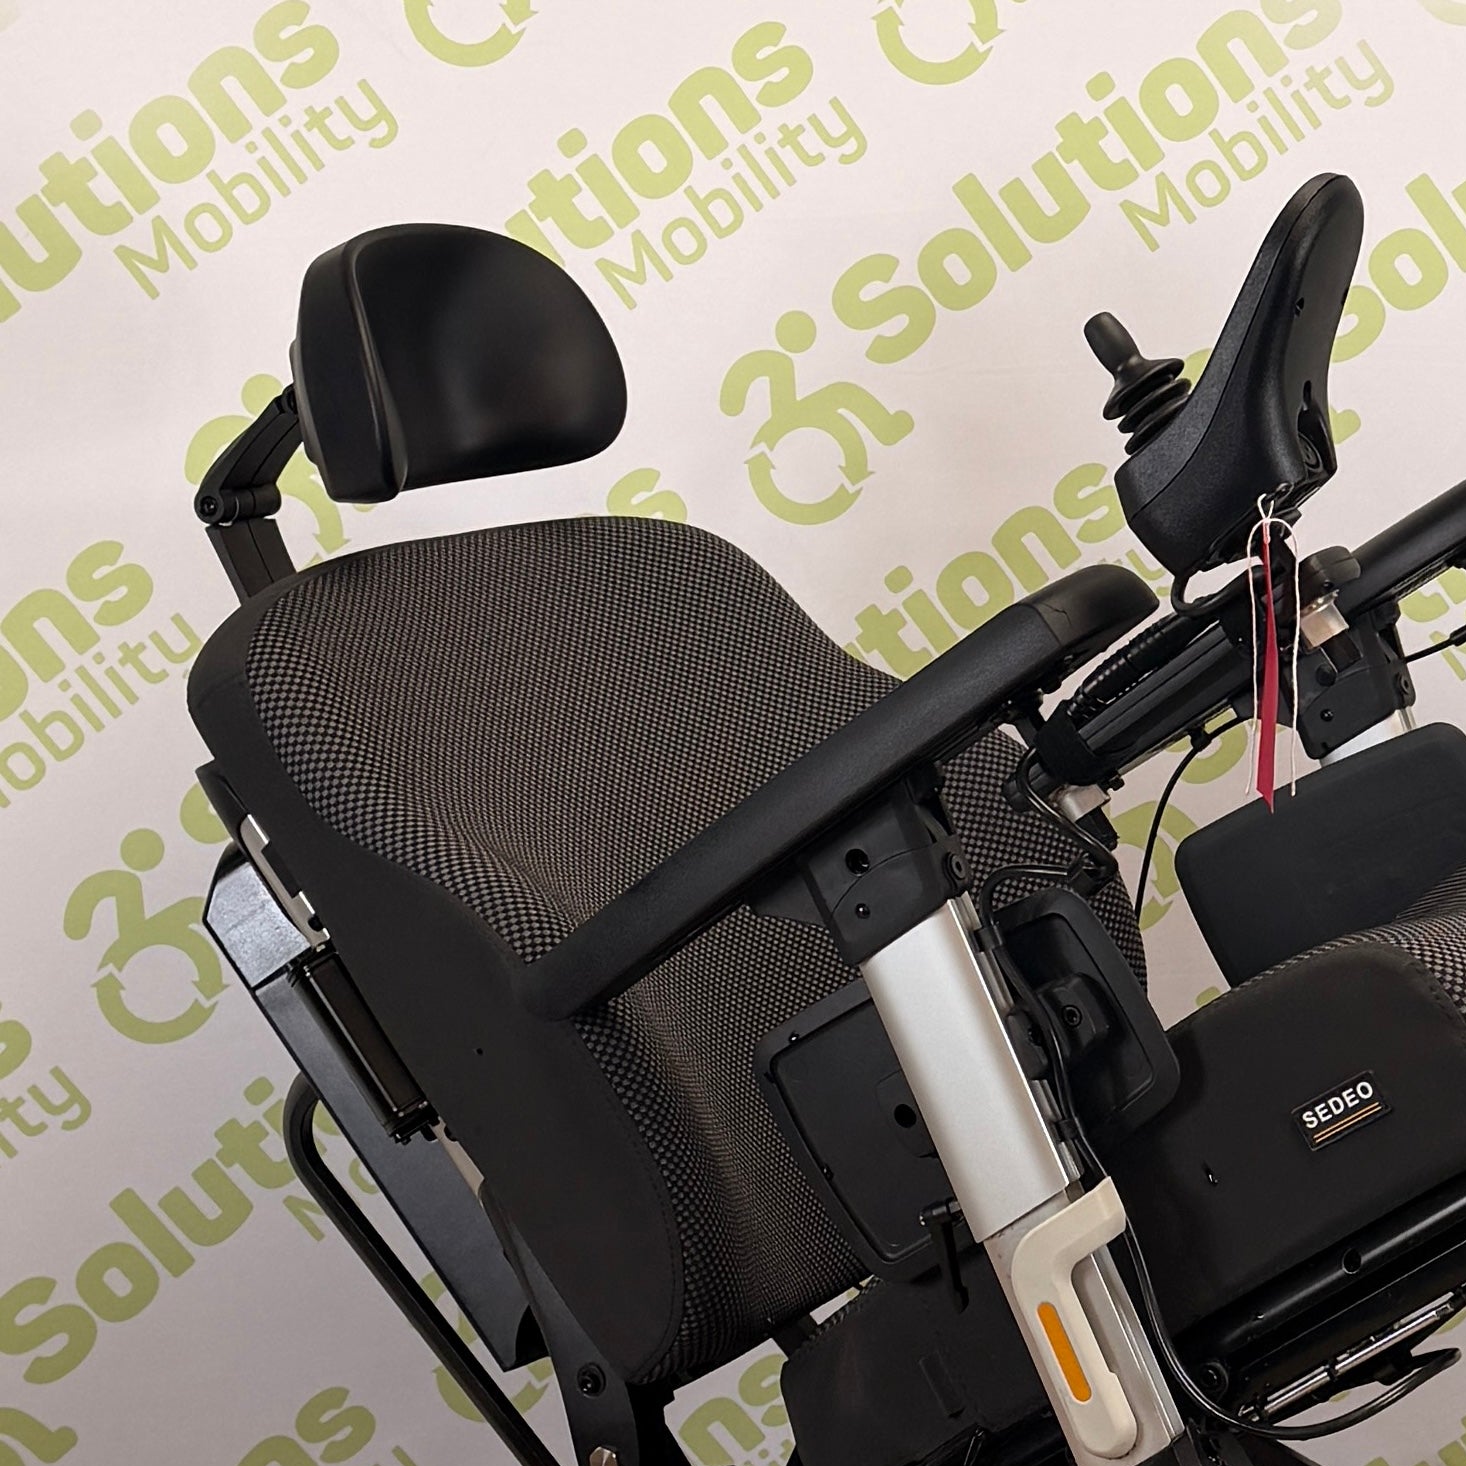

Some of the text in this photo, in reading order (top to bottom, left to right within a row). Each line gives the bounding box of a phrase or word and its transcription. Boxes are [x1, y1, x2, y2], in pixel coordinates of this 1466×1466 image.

[0, 0, 341, 322] utions
[111, 78, 400, 301] Mobility
[502, 19, 815, 270] tions
[593, 96, 869, 312] Mobility
[1117, 39, 1396, 254] Mobility
[843, 461, 1129, 682] tions
[1302, 1081, 1374, 1129] SEDEO
